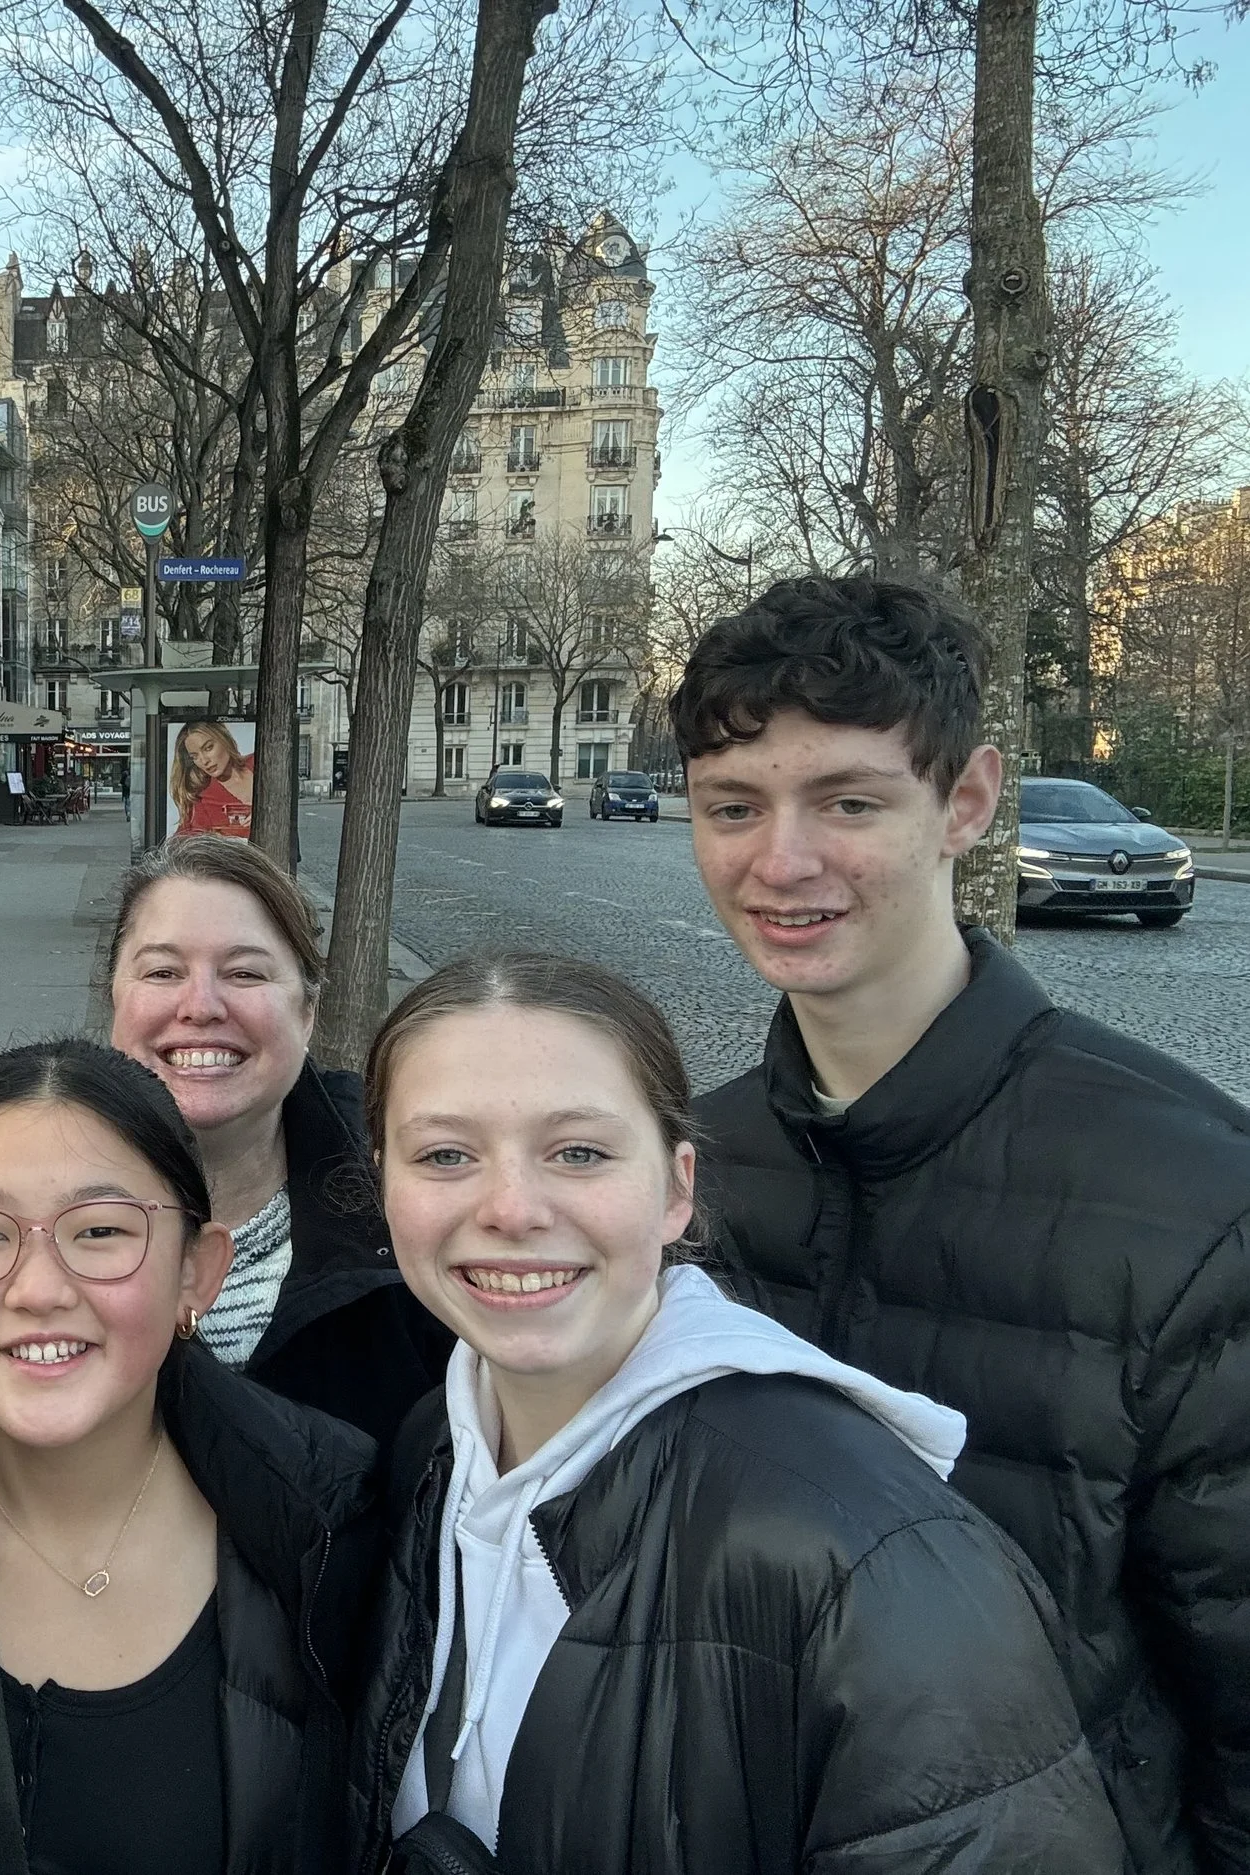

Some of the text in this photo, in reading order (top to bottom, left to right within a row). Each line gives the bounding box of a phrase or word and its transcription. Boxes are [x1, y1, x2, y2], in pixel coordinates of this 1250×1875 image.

[136, 495, 168, 513] BUS
[163, 565, 193, 575] Denfert
[200, 565, 239, 575] Rochereau
[124, 589, 139, 601] 68
